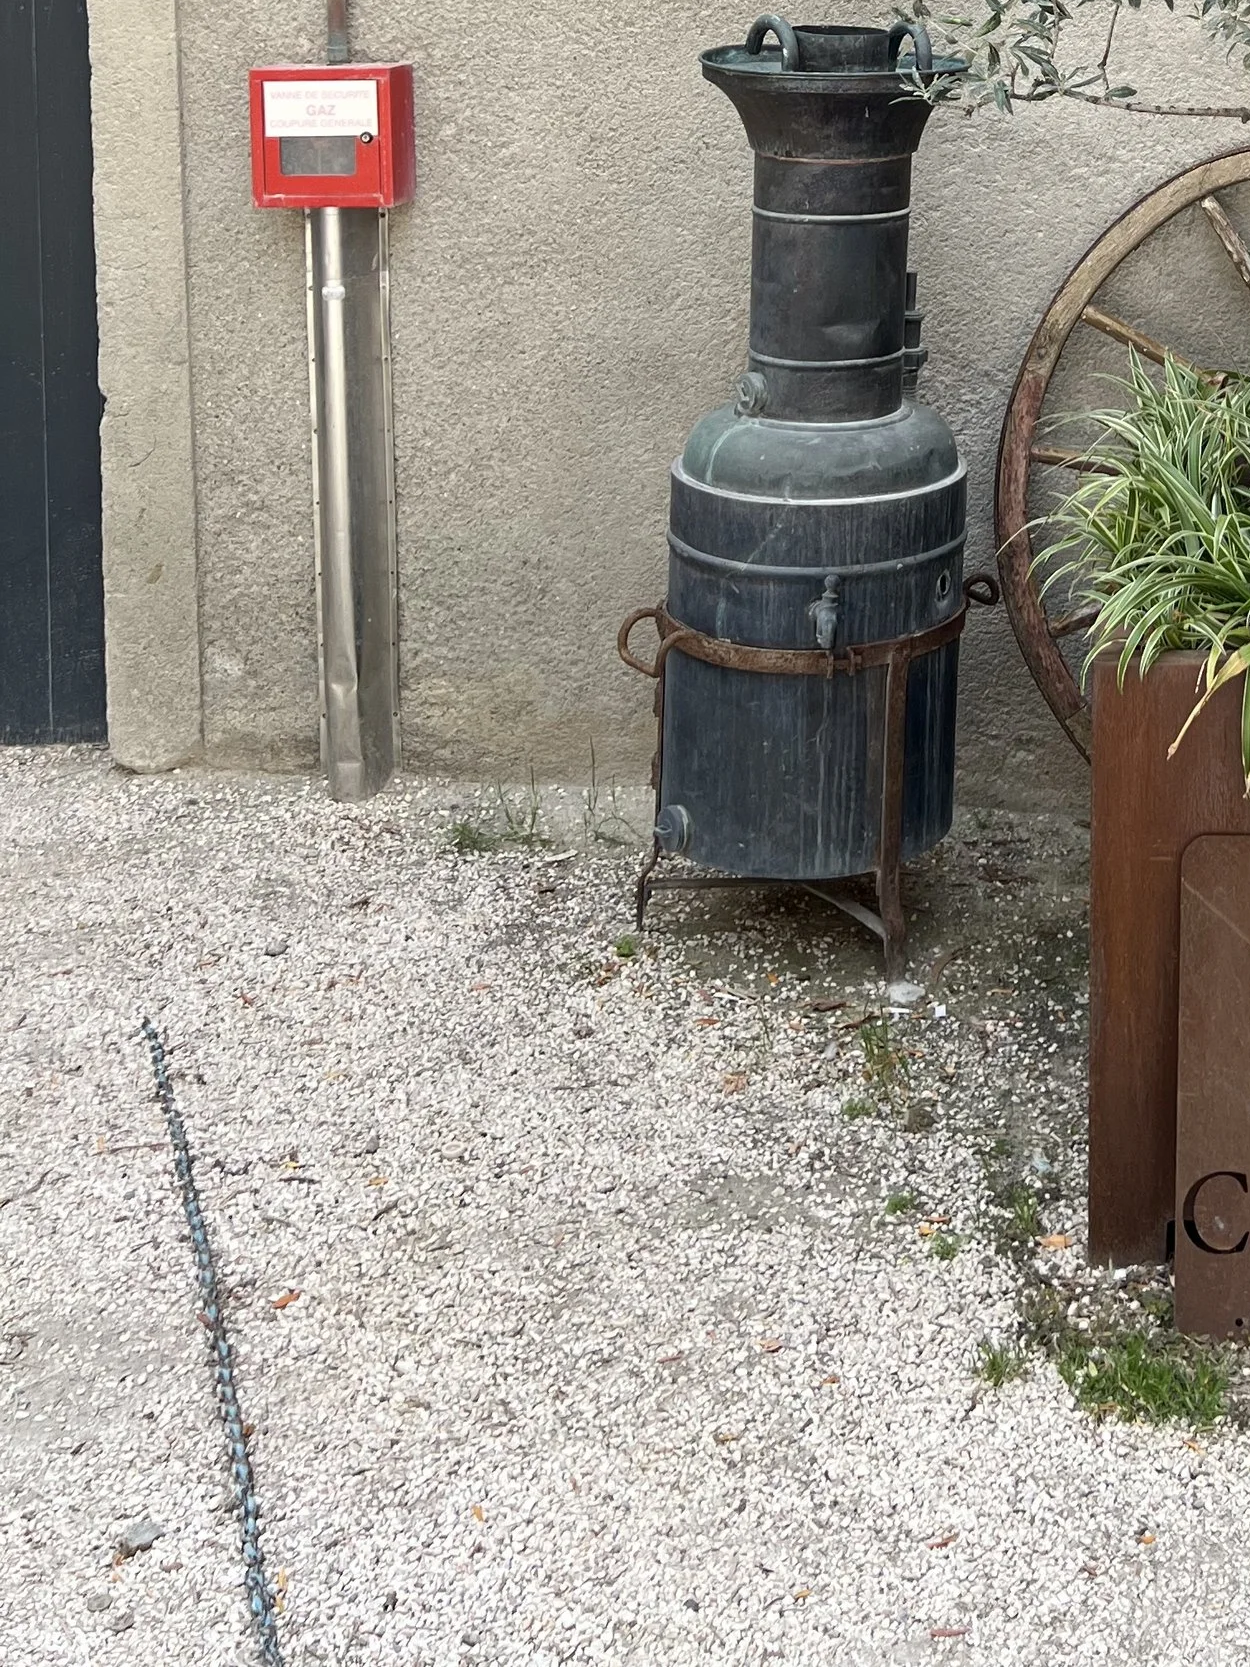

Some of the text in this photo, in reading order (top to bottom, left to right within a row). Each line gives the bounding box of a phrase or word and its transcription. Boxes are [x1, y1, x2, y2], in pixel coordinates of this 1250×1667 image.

[270, 90, 303, 100] VANNE
[305, 90, 318, 100] DE
[306, 104, 337, 116] GAZ
[270, 118, 317, 129] COUPURE
